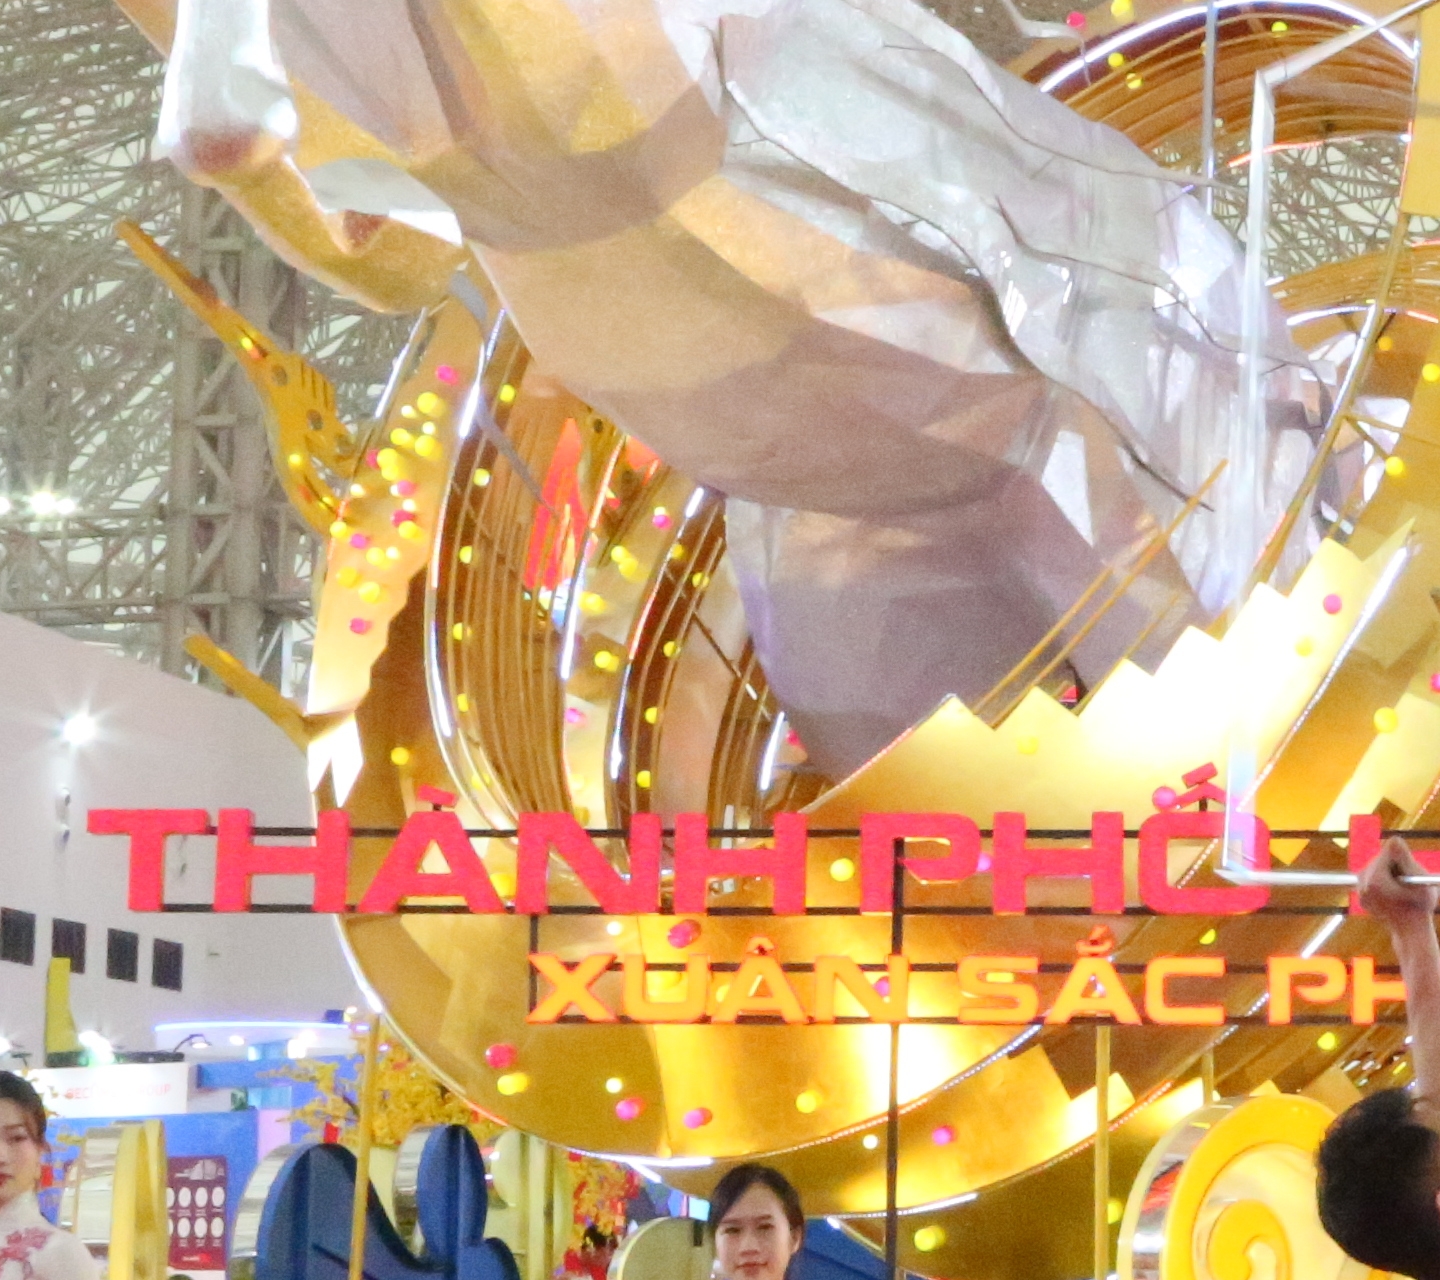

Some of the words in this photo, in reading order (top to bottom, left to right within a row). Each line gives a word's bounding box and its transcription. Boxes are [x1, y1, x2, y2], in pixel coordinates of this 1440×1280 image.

[87, 784, 808, 916] THÀNH
[860, 762, 1271, 916] PHỐ
[525, 936, 909, 1025] XUÂN
[958, 924, 1227, 1026] SẮC
